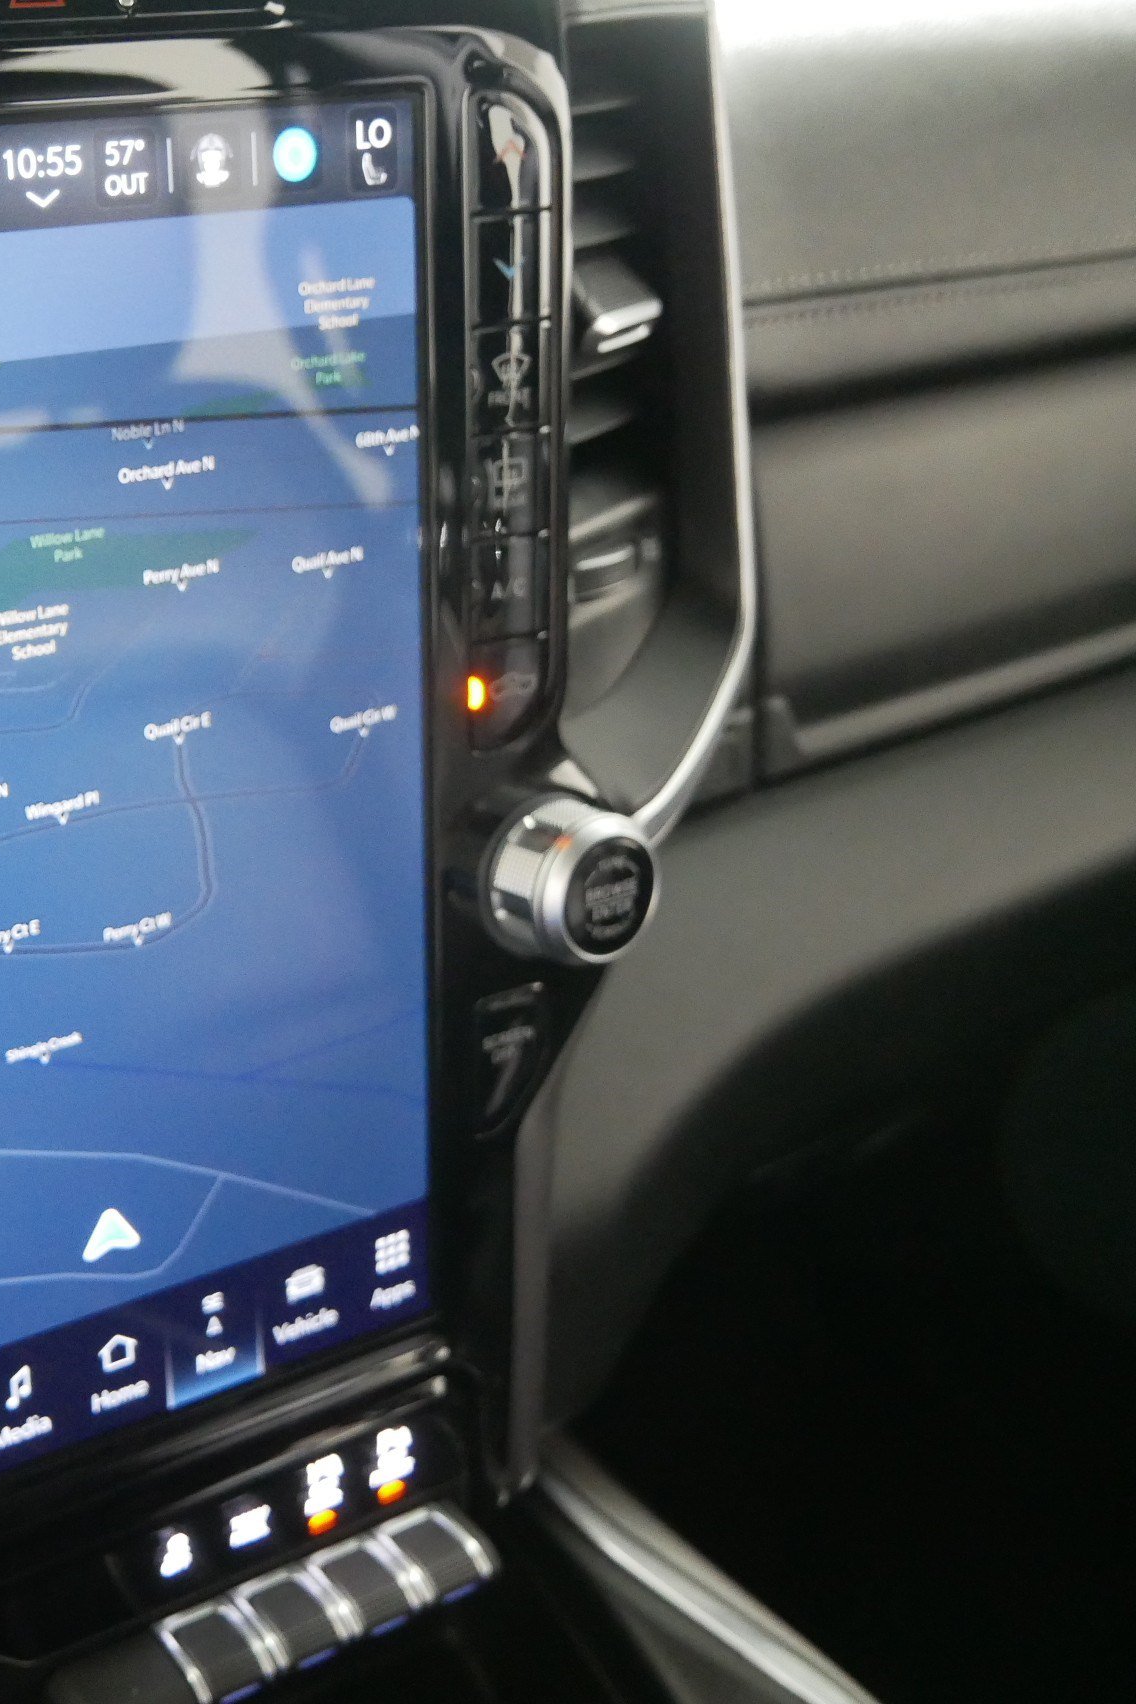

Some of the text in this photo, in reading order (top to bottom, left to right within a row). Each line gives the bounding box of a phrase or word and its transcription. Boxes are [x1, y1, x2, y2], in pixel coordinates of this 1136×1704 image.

[354, 117, 393, 150] LO
[2, 144, 83, 180] 10:55
[104, 171, 149, 197] OUT
[117, 455, 216, 484] Orchard Ave N
[37, 603, 70, 620] Lane
[11, 638, 57, 660] School
[90, 1379, 151, 1415] Home
